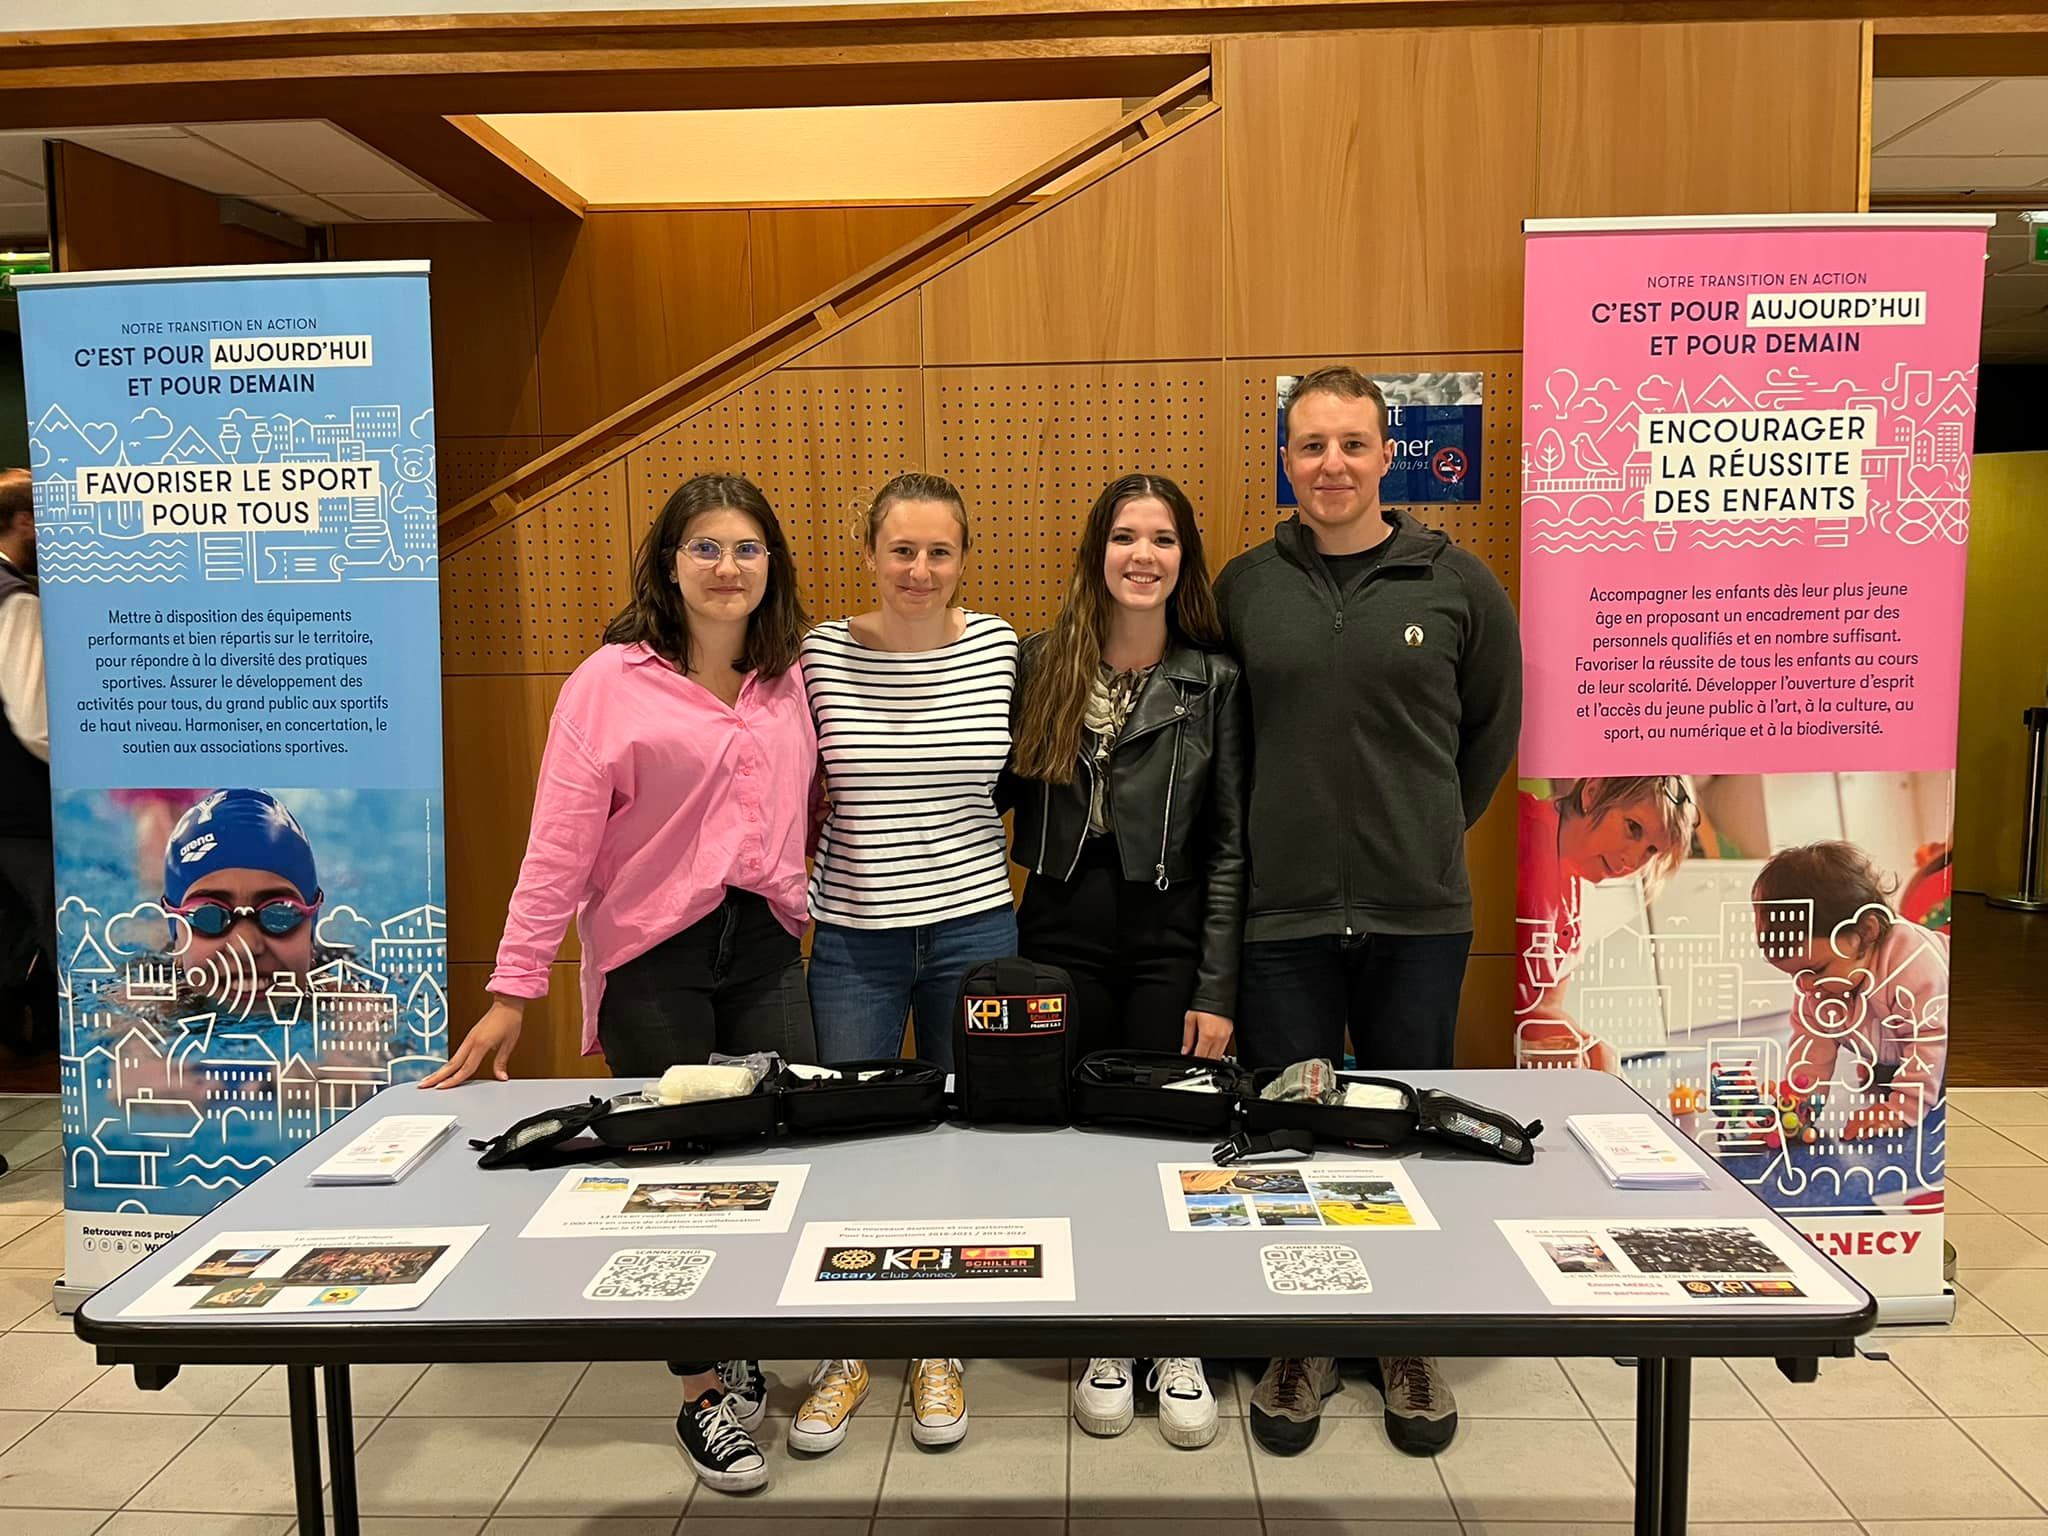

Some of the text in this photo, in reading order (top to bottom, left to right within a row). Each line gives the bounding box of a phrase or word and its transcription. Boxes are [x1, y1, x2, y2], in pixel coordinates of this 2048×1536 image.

[1647, 272, 1866, 288] NOTRE TRANSITION EN ACTION
[1591, 297, 1919, 323] C'EST POUR AUJOURD'HUI
[121, 318, 316, 334] NOTRE TRANSITION EN ACTION
[74, 340, 366, 367] C'EST POUR AUJOURD'HUI
[1650, 331, 1859, 355] ET POUR DEMAIN
[128, 373, 314, 396] ET POUR DEMAIN
[1650, 416, 1864, 444] ENCOURAGER
[1662, 448, 1849, 478] LA RÉUSSITE
[86, 467, 372, 494] FAVORISER LE SPORT
[1655, 486, 1854, 513] DES ENFANTS
[152, 501, 308, 526] POUR TOUS
[1589, 581, 1907, 605] Accompagner les enfants dès leur plus jeune
[108, 608, 351, 626] Mettre à disposition des équipements
[1595, 604, 1899, 629] âge en proposant un encadrement par des
[88, 629, 373, 649] performants et bien répartis sur le territoire,
[1593, 627, 1901, 652] personnels qualifiés et en nombre suffisant.
[95, 651, 367, 671] pour répondre à la diversité des pratiques
[1575, 651, 1918, 671] Favoriser la réussite de tous les enfants au cours
[102, 673, 362, 692] sportives. Assurer le développement des
[1577, 673, 1914, 695] de leur scolarité. Développer l'ouverture d'esprit
[77, 694, 388, 714] activités pour tous, du grand public aux sportifs
[1576, 697, 1913, 719] et l'accès du jeune public à l'art, à la culture, au
[79, 717, 387, 733] de haut niveau. Harmoniser, en concertation, le
[1604, 720, 1883, 743] sport, au numérique et à la biodiversité.
[122, 739, 348, 756] soutien aux associations sportives.
[180, 833, 215, 857] arena
[82, 1226, 132, 1237] Retrouvez
[134, 1230, 151, 1238] nos
[819, 1271, 958, 1280] Rotary Club Annecy
